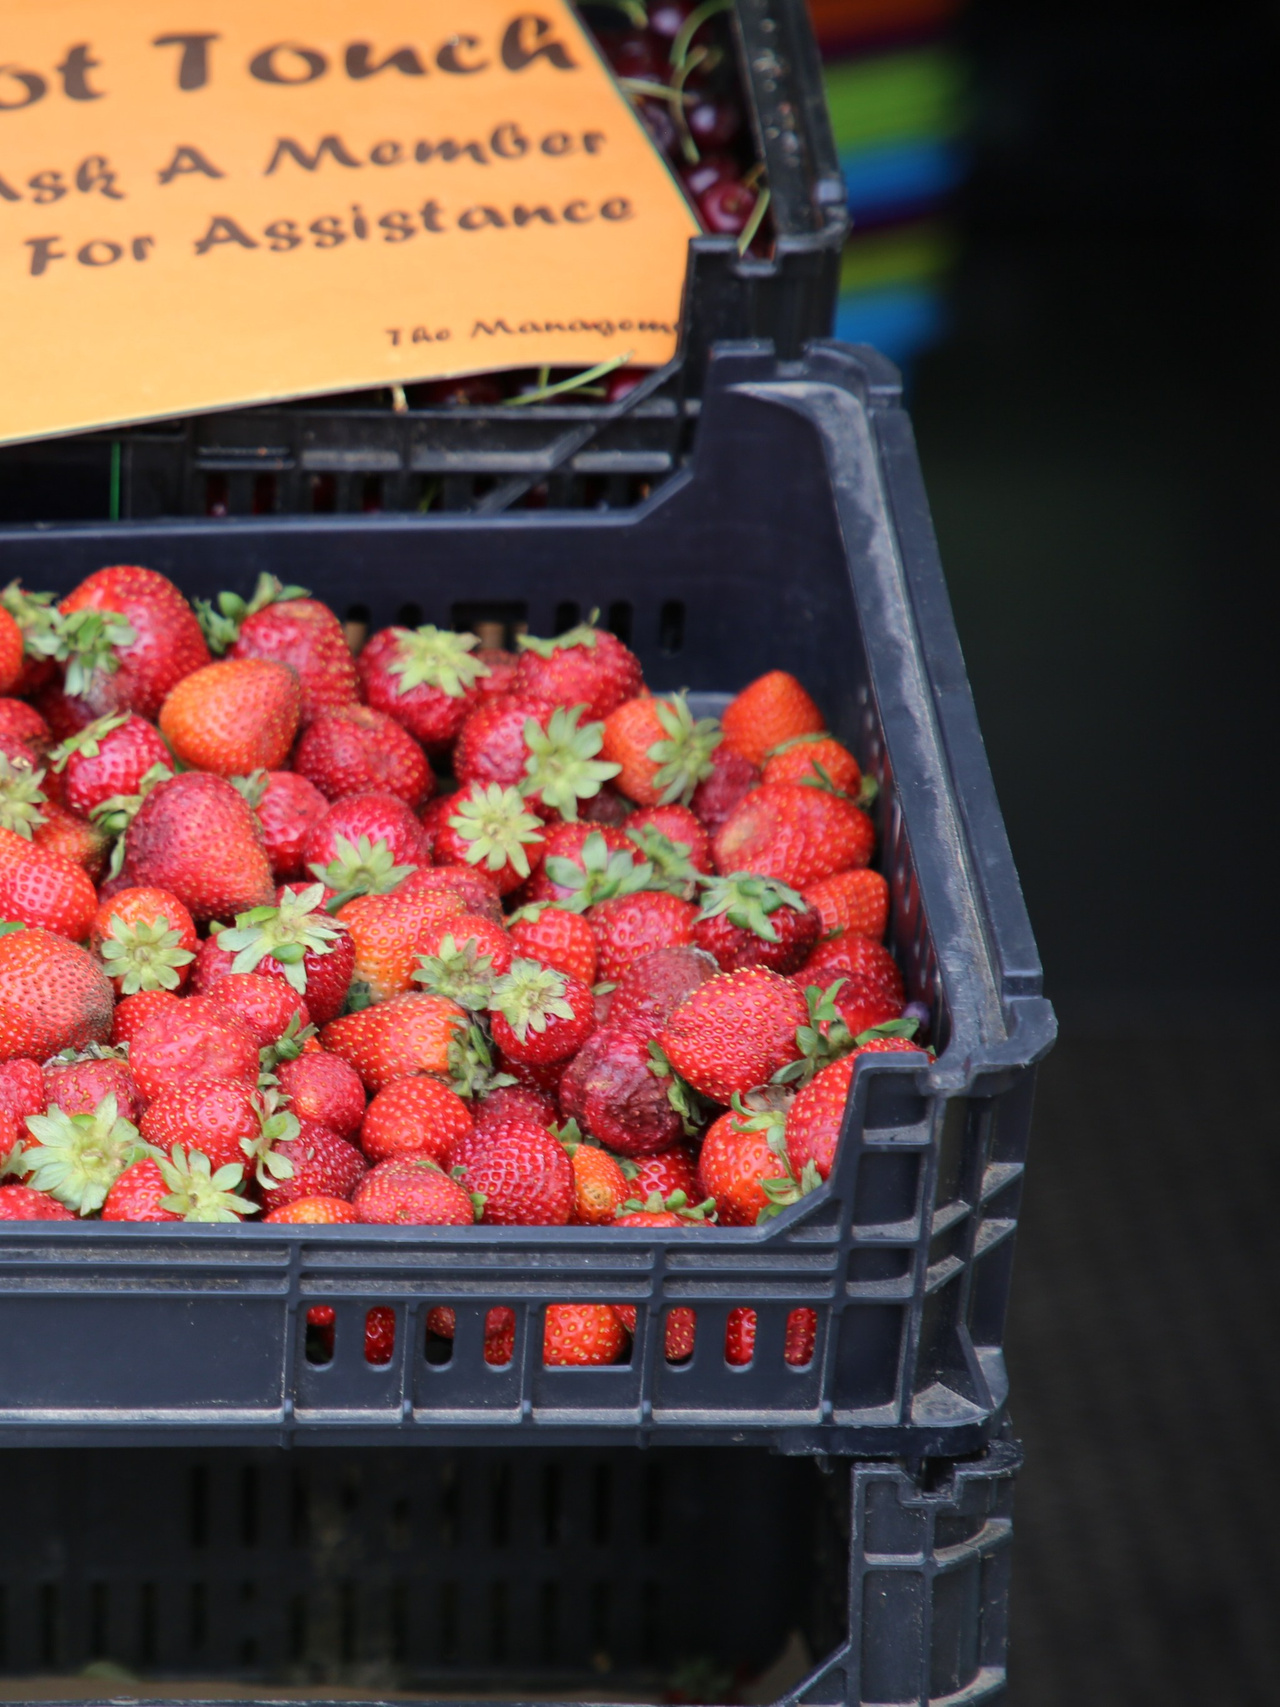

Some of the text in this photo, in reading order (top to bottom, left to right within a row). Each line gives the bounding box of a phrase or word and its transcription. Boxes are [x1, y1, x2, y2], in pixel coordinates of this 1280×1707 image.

[151, 13, 581, 93] Touch
[157, 145, 226, 185] A
[263, 122, 608, 176] Member
[23, 235, 156, 277] For
[194, 197, 636, 256] Assistance
[385, 326, 452, 347] The
